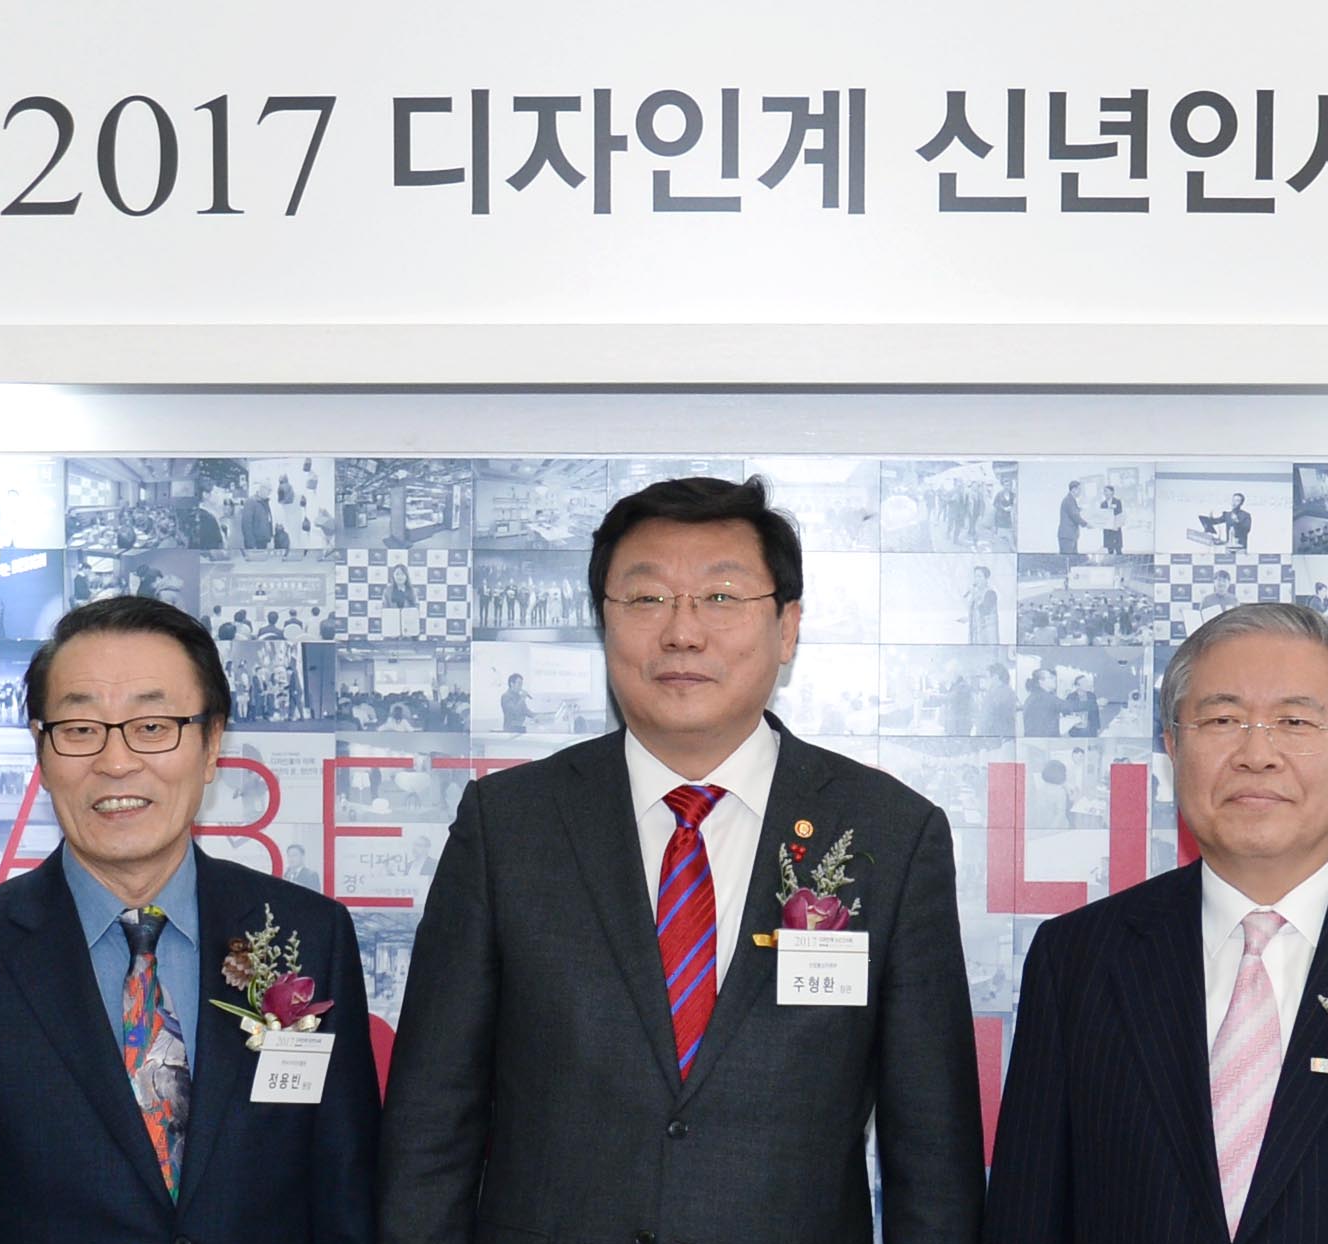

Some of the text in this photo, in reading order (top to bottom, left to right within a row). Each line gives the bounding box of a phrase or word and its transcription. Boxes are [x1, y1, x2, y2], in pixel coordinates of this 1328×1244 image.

[0, 94, 336, 217] 2017
[392, 88, 866, 214] 디자인계
[793, 976, 835, 993] 주형환
